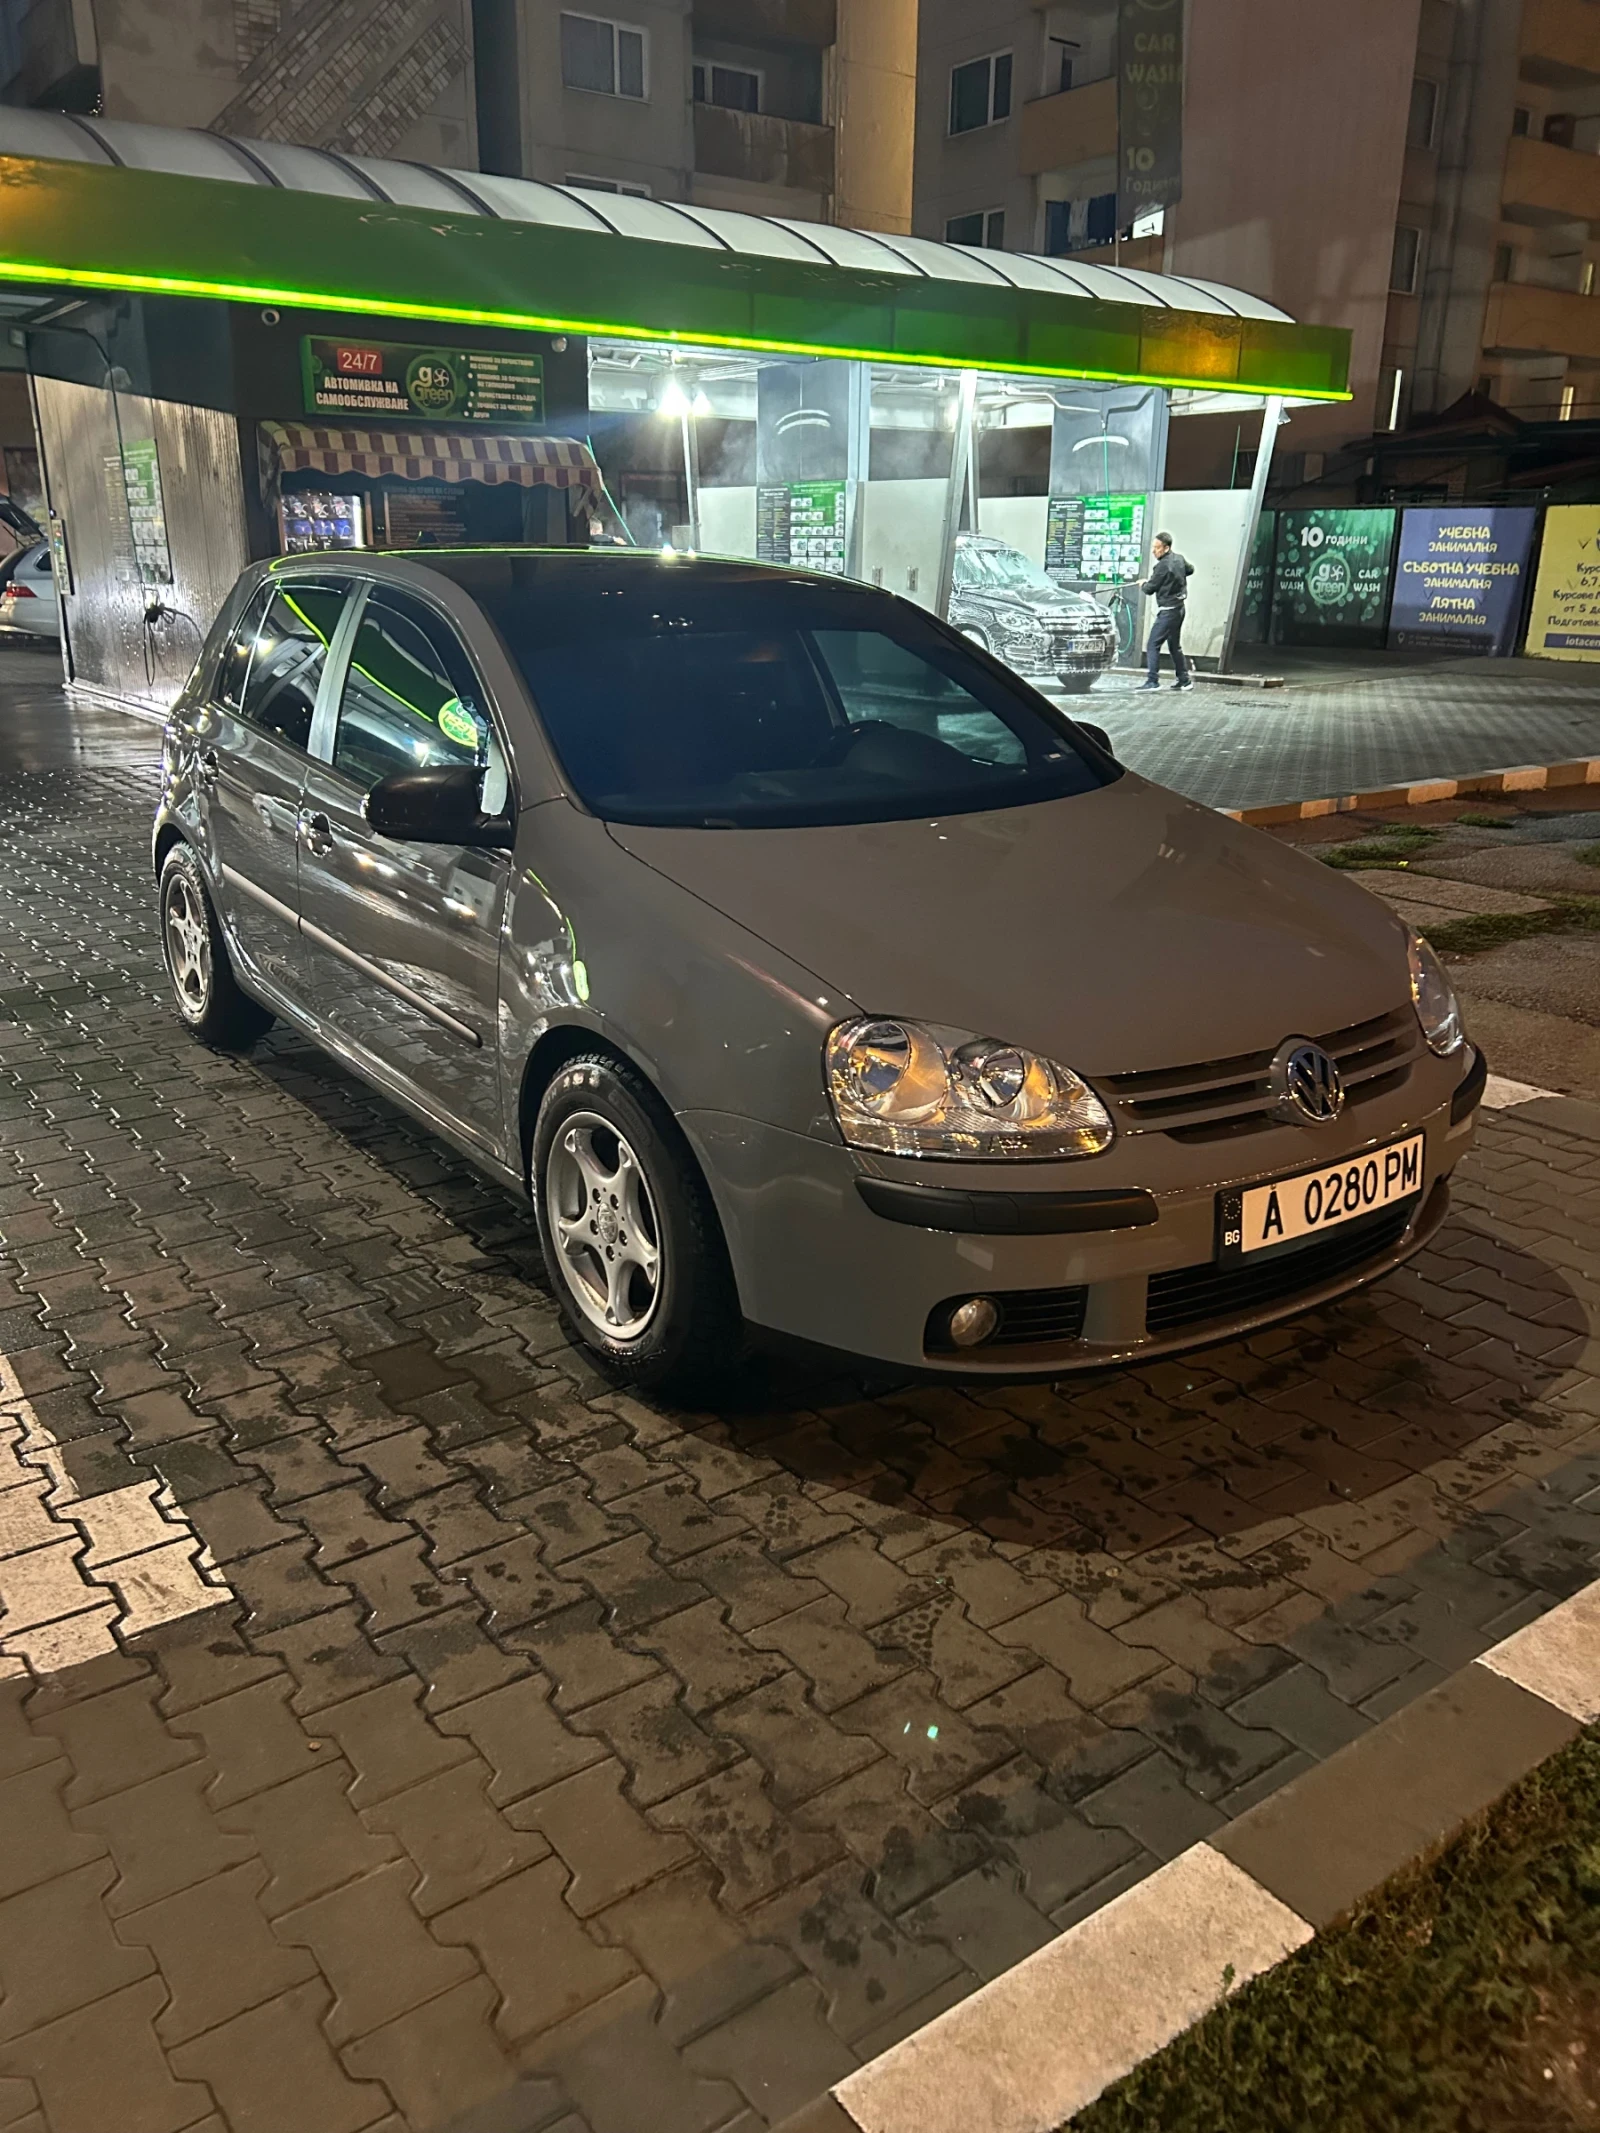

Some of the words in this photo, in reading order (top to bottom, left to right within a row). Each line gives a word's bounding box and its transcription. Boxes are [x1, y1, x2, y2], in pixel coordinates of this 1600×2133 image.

[1134, 32, 1176, 52] CAR
[1127, 147, 1155, 171] 10
[343, 352, 377, 370] 24/7
[324, 377, 384, 393] АВТОМИВКА
[385, 381, 398, 394] НА
[316, 392, 409, 410] САМООБСЛУЖВАНЕ
[1301, 526, 1324, 548] 10
[1438, 525, 1491, 540] УЧЕБНА
[1428, 541, 1498, 554] ЗАНИМАЛНЯ
[1248, 567, 1261, 577] AR
[1284, 568, 1302, 578] CAR
[1358, 569, 1378, 580] CAR
[1403, 561, 1464, 575] СЪБОТНА
[1466, 562, 1520, 576] УЧЕБНА
[1246, 579, 1264, 589] ASH
[1280, 581, 1304, 591] WASH
[1353, 582, 1381, 593] WASH
[1423, 577, 1493, 590] ЗАНИМАЛНЯ
[1553, 589, 1594, 602] Курсове
[1430, 596, 1476, 611] ЛЯТНА
[1564, 605, 1575, 613] от
[1578, 603, 1586, 613] 5
[1418, 611, 1488, 626] ЗАНИМАЛНЯ
[1262, 1190, 1284, 1240] A
[1304, 1160, 1378, 1225] 0280
[1384, 1143, 1418, 1198] PM
[1224, 1230, 1240, 1246] BG
